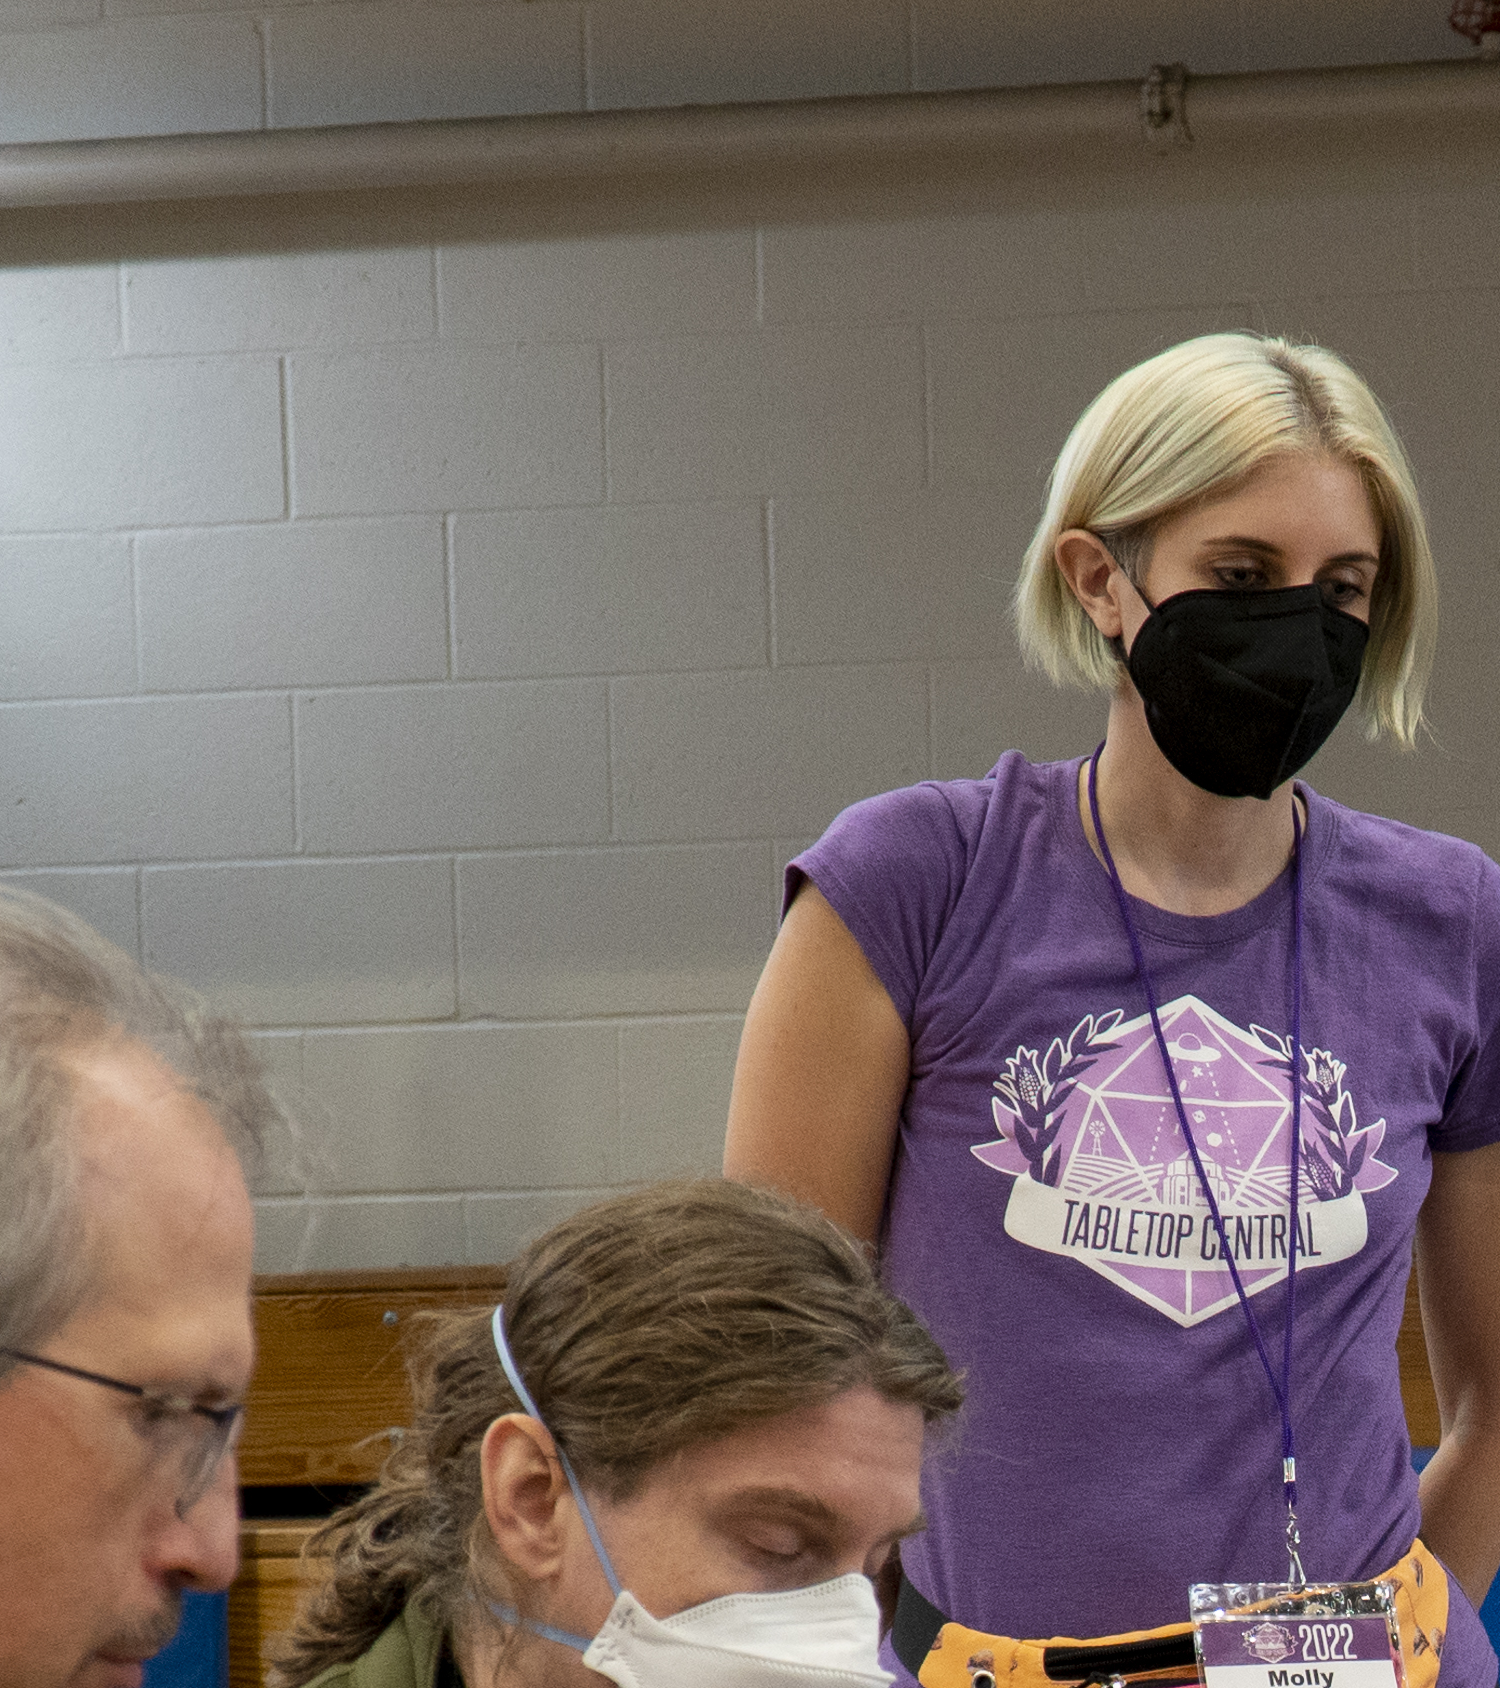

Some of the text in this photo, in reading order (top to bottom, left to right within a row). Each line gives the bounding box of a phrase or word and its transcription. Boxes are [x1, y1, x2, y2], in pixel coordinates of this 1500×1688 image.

[1061, 1199, 1194, 1259] TABLETOP
[1298, 1623, 1357, 1661] 2022
[1268, 1669, 1334, 1688] Molly
